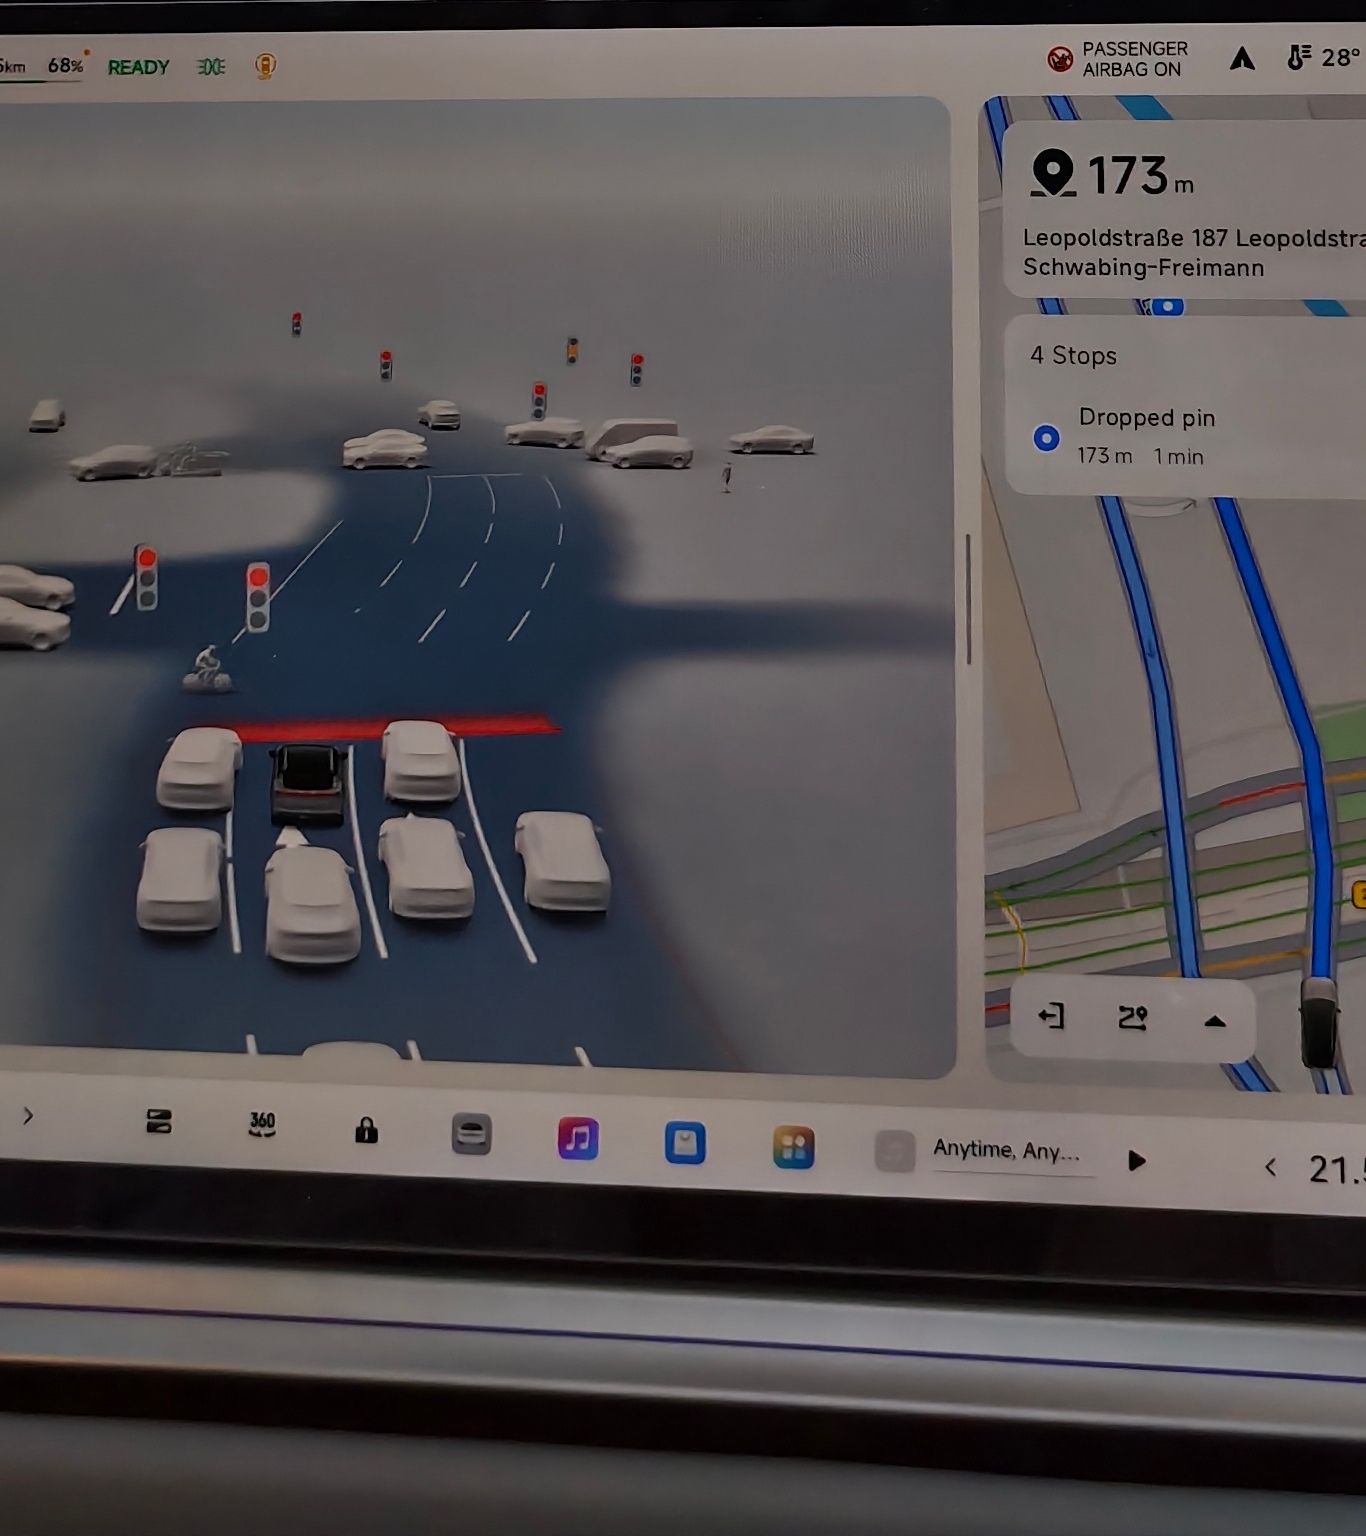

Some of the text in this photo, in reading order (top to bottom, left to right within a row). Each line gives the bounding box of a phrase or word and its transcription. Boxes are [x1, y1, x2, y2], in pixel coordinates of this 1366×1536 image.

[1083, 40, 1189, 57] PASSENGER
[1322, 47, 1361, 67] 28°
[48, 57, 84, 74] 68%
[108, 59, 170, 76] READY
[1082, 61, 1181, 78] AIRBAG ON
[1089, 155, 1194, 195] 173 m
[1023, 227, 1184, 252] Leopoldstraße
[1191, 228, 1229, 247] 187
[1023, 257, 1264, 281] Schwabing-Freimann
[1030, 344, 1117, 370] 4 Stops
[1080, 406, 1215, 432] Dropped pin
[1078, 446, 1133, 465] 173 m
[1154, 447, 1204, 466] 1 min
[249, 1110, 276, 1129] 360
[933, 1137, 1016, 1161] Anytime,
